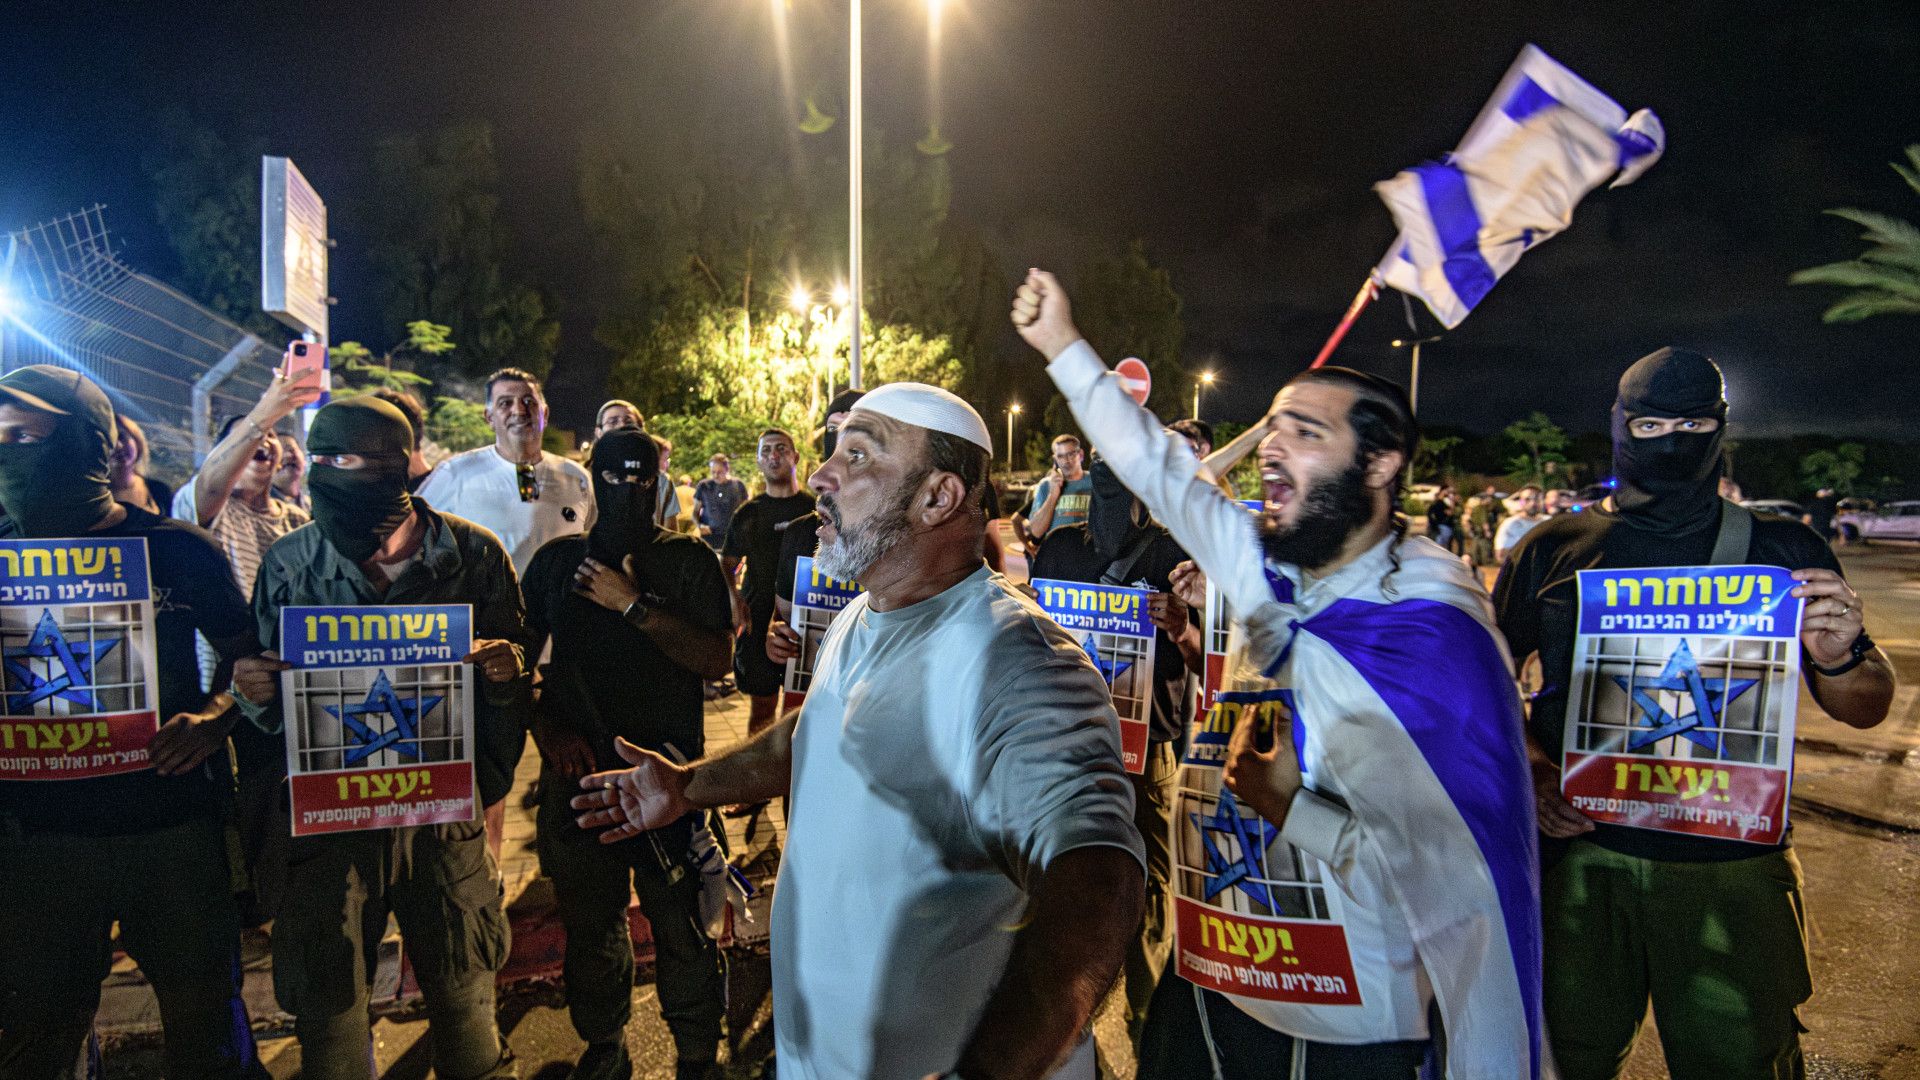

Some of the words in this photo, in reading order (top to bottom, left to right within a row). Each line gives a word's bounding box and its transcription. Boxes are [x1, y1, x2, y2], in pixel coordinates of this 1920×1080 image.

[0, 585, 50, 601] הגיב
[57, 580, 127, 599] חיילינו
[807, 592, 853, 607] יבורים
[1046, 611, 1094, 627] הגיבורי
[1098, 616, 1140, 632] חיילינו
[1600, 614, 1690, 630] הגיבורים
[1697, 610, 1774, 632] חיילינו
[304, 648, 384, 664] הגיבורים
[392, 643, 451, 661] חיילינו
[0, 757, 40, 775] הקונס
[45, 754, 88, 770] ואלופי
[303, 806, 370, 824] הקונספציה
[374, 801, 412, 816] ואלופי
[1654, 800, 1700, 822] ואלופי
[1233, 964, 1278, 989] ואלופי
